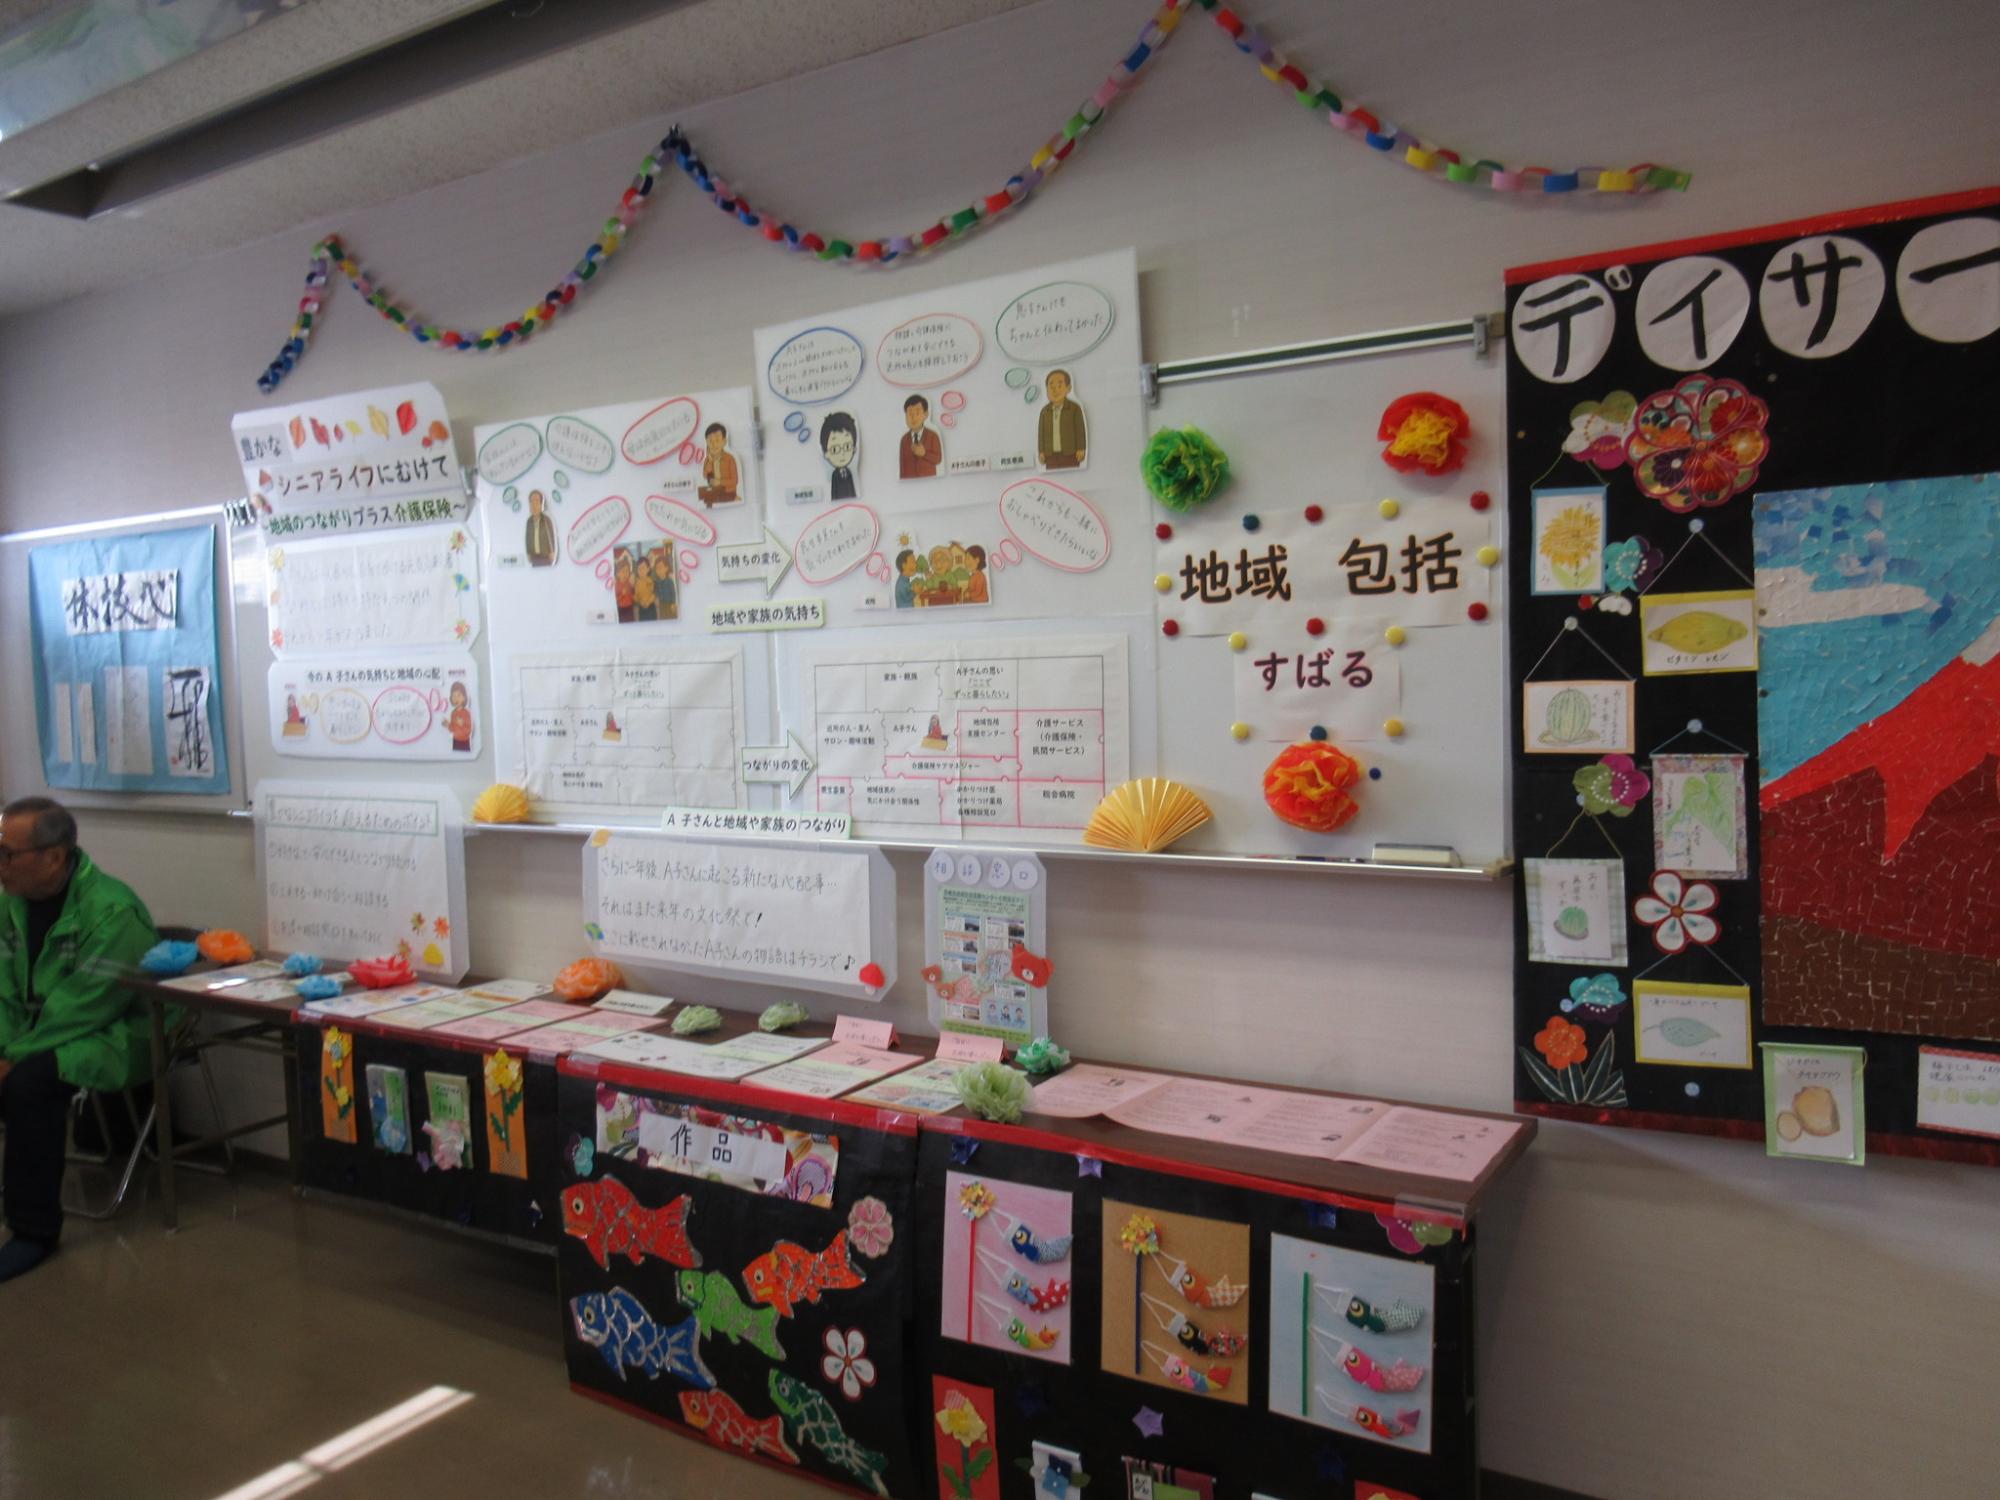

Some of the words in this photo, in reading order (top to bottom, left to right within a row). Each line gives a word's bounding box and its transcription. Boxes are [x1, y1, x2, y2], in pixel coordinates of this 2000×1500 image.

[279, 455, 449, 496] シニアライフにむけて
[721, 552, 782, 569] 気持ちの変化
[1180, 545, 1292, 604] 地域
[1338, 532, 1462, 597] 包括
[711, 605, 822, 627] 地域や家族の気持ち
[1254, 648, 1374, 692] すばる
[1036, 718, 1085, 728] 介護サービス
[744, 758, 811, 772] つながりの変化
[670, 1122, 732, 1163] 作品
